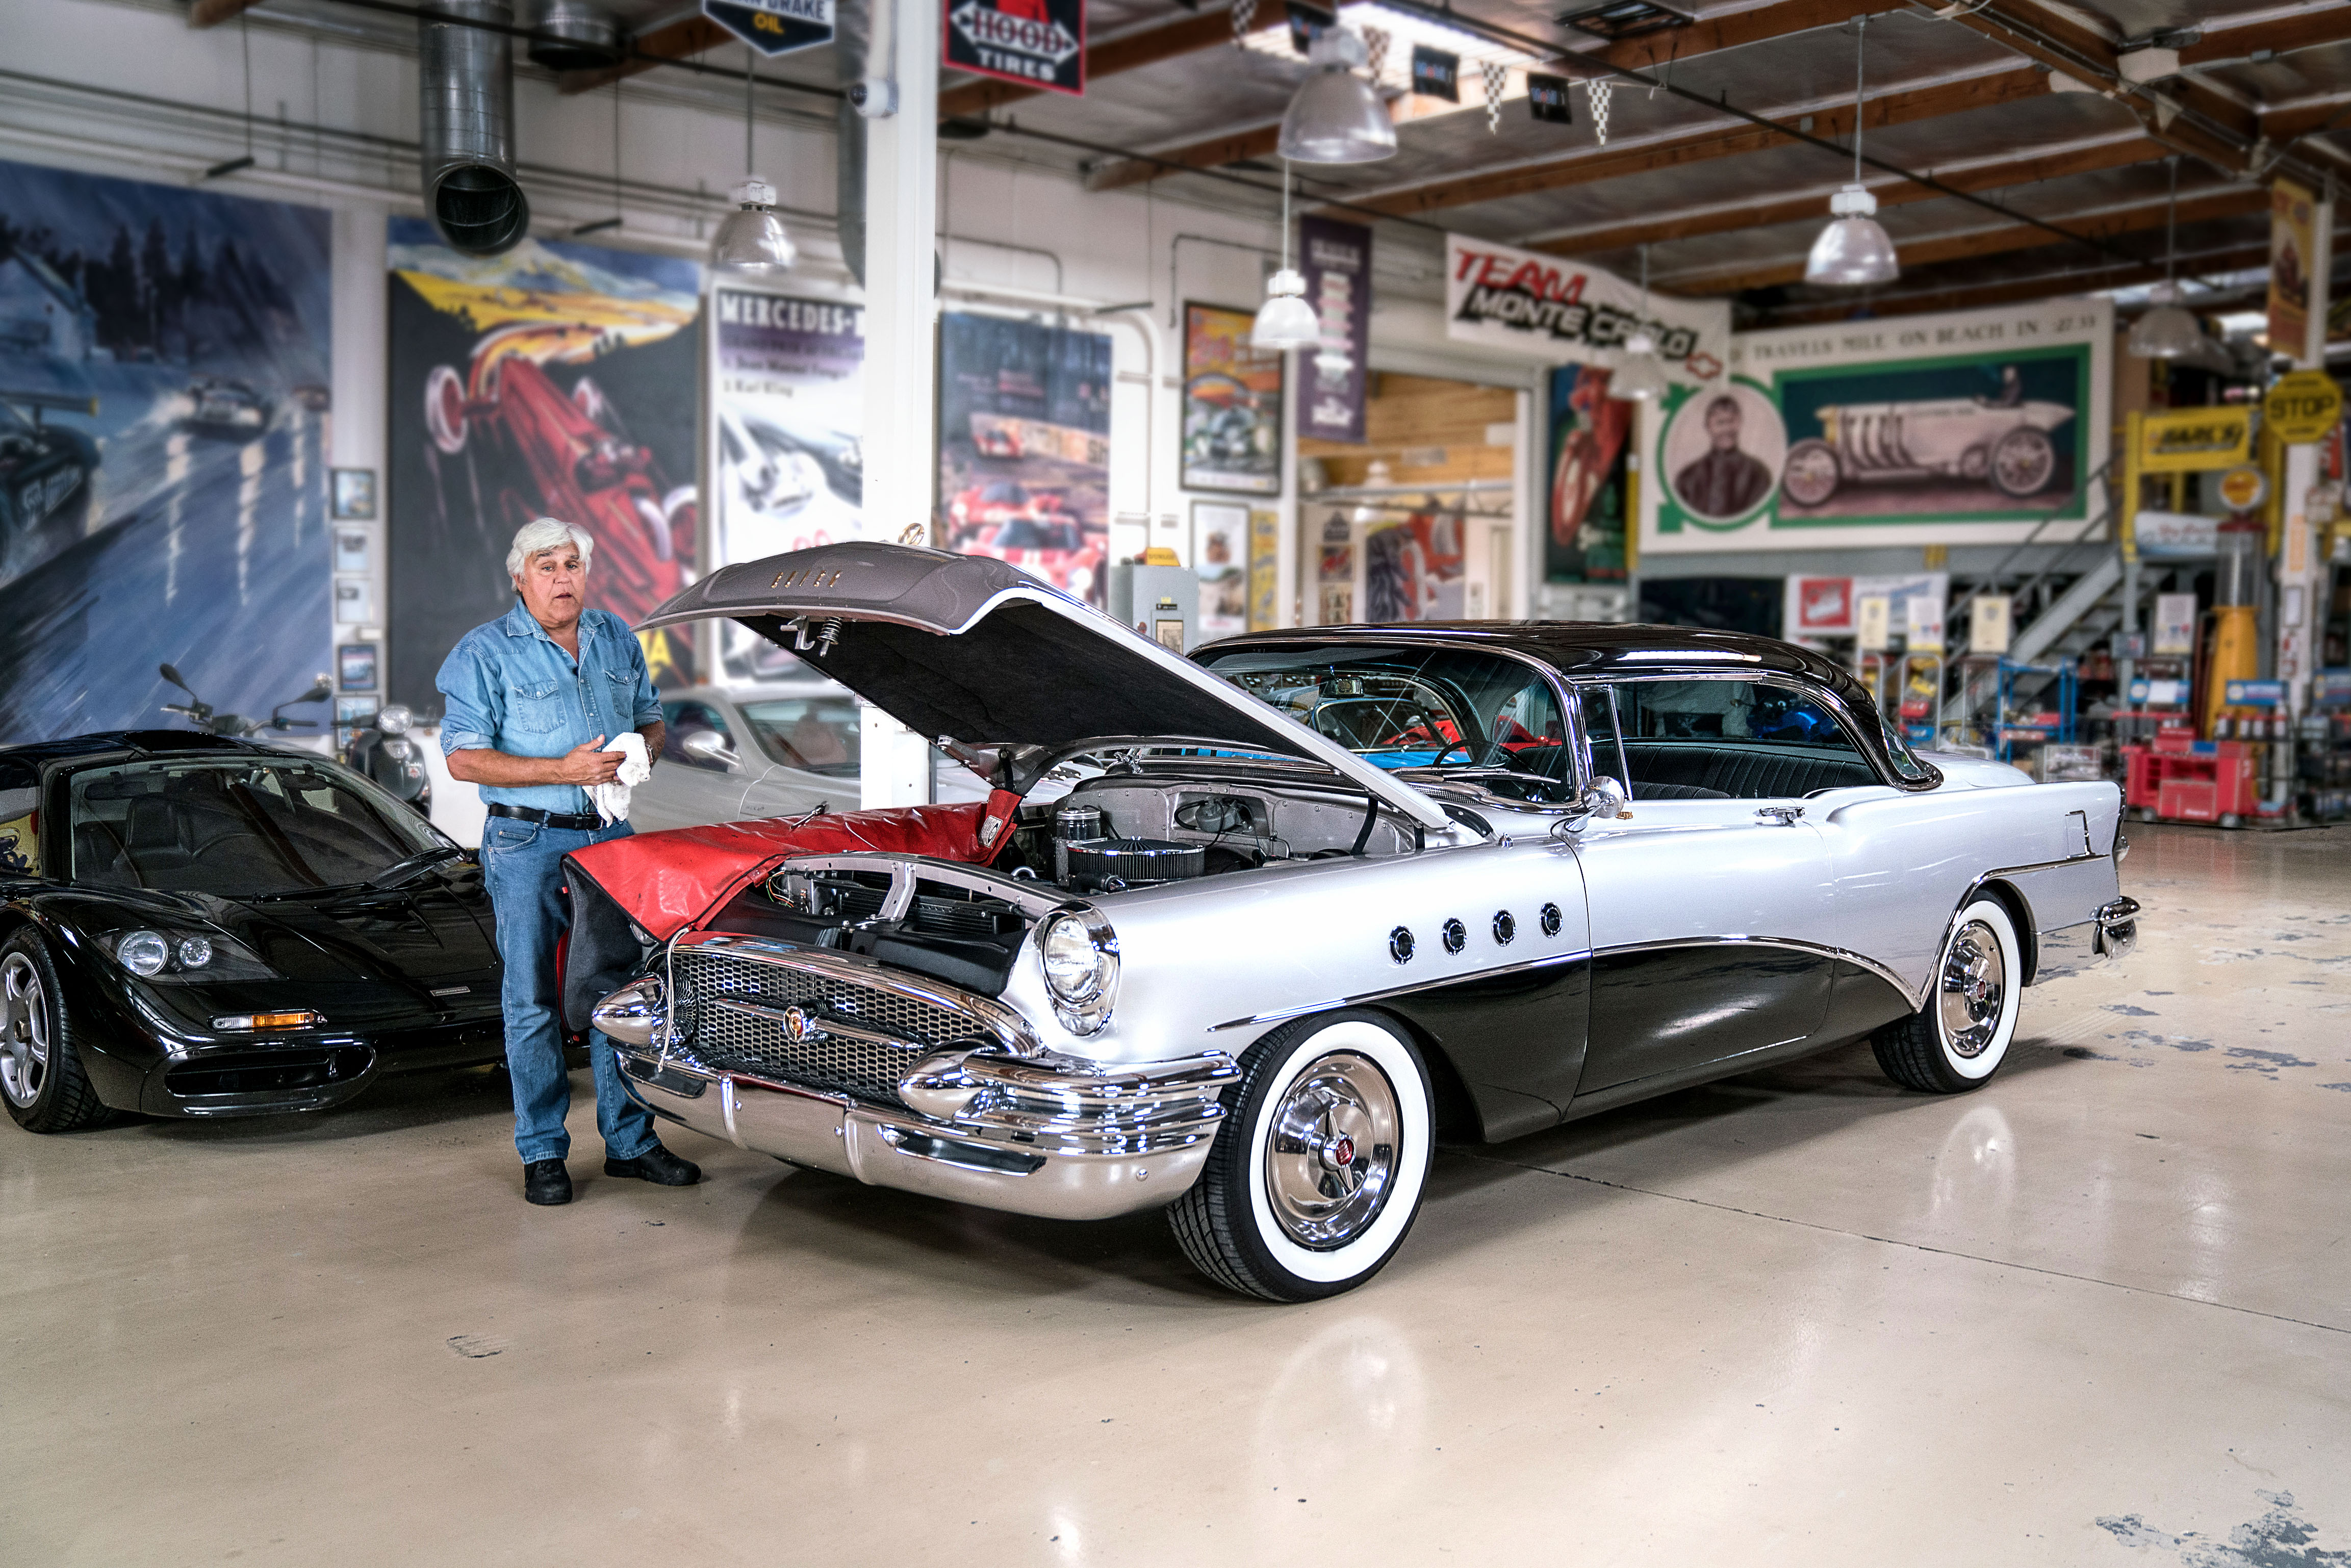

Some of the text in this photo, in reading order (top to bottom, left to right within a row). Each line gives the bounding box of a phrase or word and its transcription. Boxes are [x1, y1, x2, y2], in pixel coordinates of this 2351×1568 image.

[754, 12, 784, 35] OIL
[973, 9, 1062, 53] HOOD
[977, 48, 1055, 81] TIRES
[1455, 248, 1587, 305] TEAM
[1456, 284, 1585, 341] MONTE
[1842, 333, 1885, 351] MILE
[1899, 330, 1927, 347] ON
[1938, 323, 2004, 344] BEACH
[2016, 320, 2038, 338] IN
[2269, 395, 2335, 420] STOP
